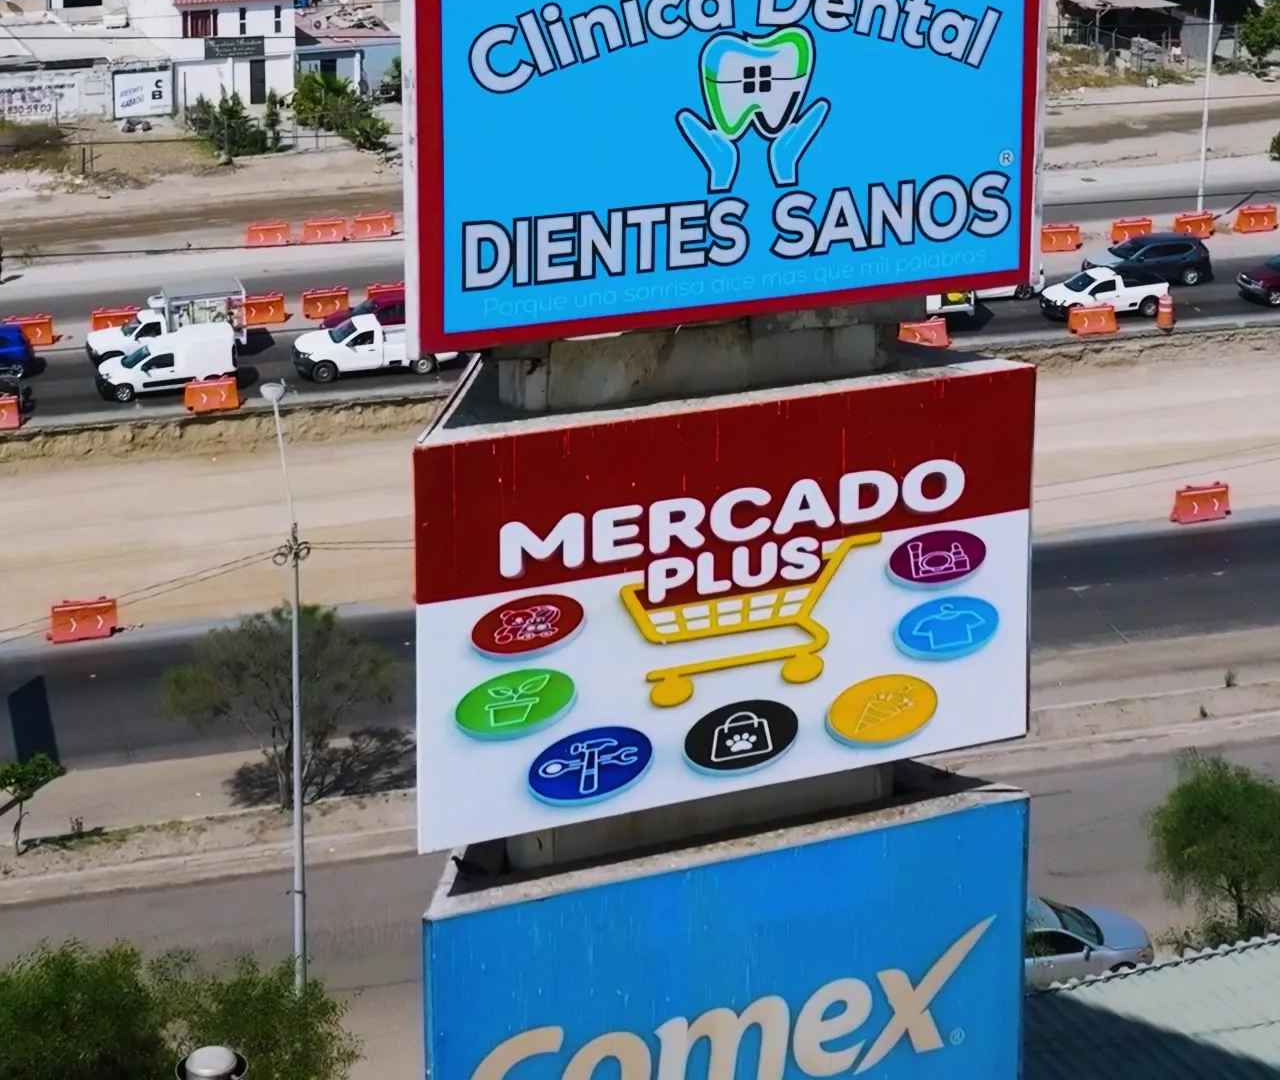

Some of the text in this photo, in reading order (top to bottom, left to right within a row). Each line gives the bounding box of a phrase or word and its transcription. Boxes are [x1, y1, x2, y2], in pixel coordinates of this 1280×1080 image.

[462, 171, 1011, 291] DIENTES SANOS
[483, 293, 567, 317] Porque
[574, 289, 617, 307] una
[624, 276, 704, 301] sonrisa
[711, 273, 755, 292] dice
[813, 264, 854, 285] que
[860, 256, 891, 276] mil
[896, 248, 987, 275] palabras
[498, 458, 966, 580] MERCADO
[647, 536, 821, 603] PLUS
